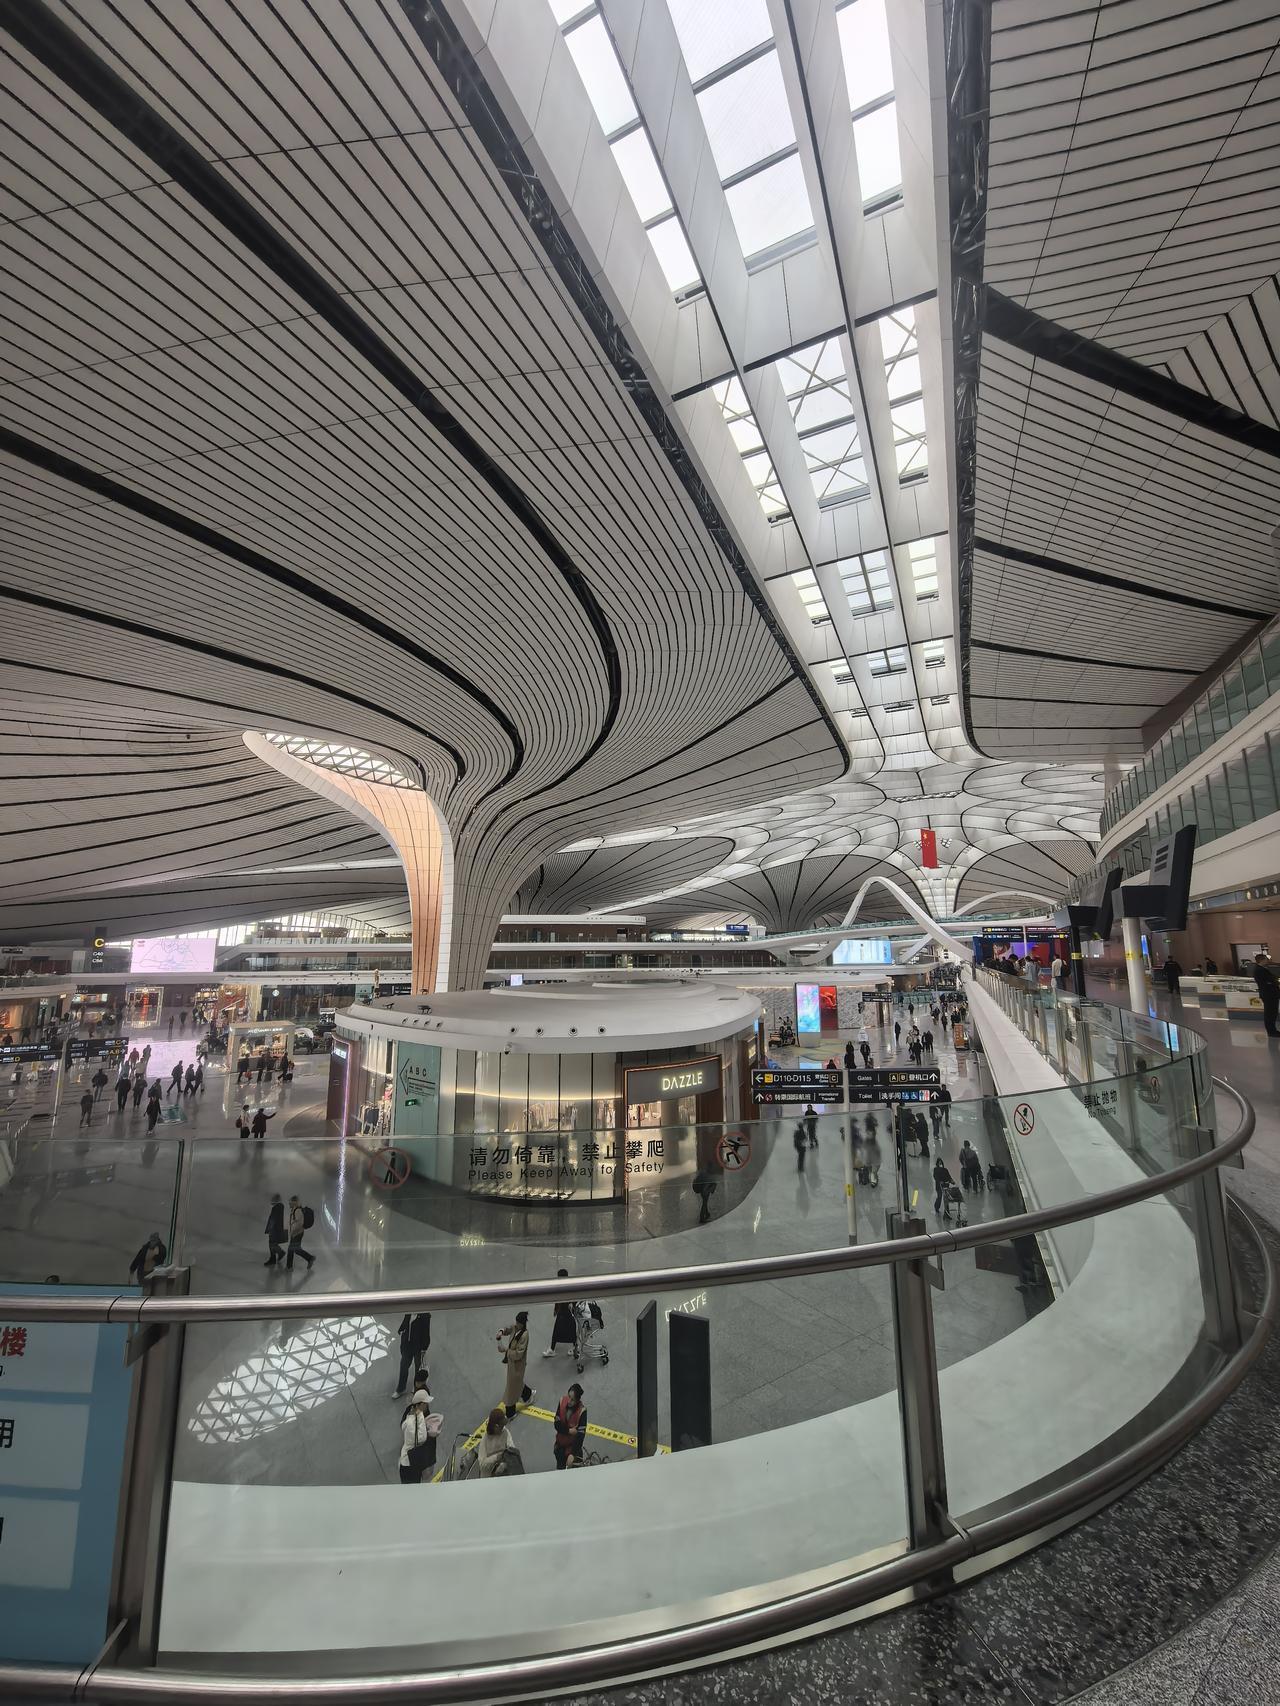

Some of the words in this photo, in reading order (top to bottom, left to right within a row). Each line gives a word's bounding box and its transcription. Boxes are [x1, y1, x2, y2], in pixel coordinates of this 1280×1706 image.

[94, 938, 105, 948] C
[662, 1071, 704, 1091] DAZZLE
[468, 1169, 513, 1181] Please
[521, 1167, 553, 1180] Keep
[560, 1165, 594, 1178] Away
[625, 1161, 665, 1174] Safety
